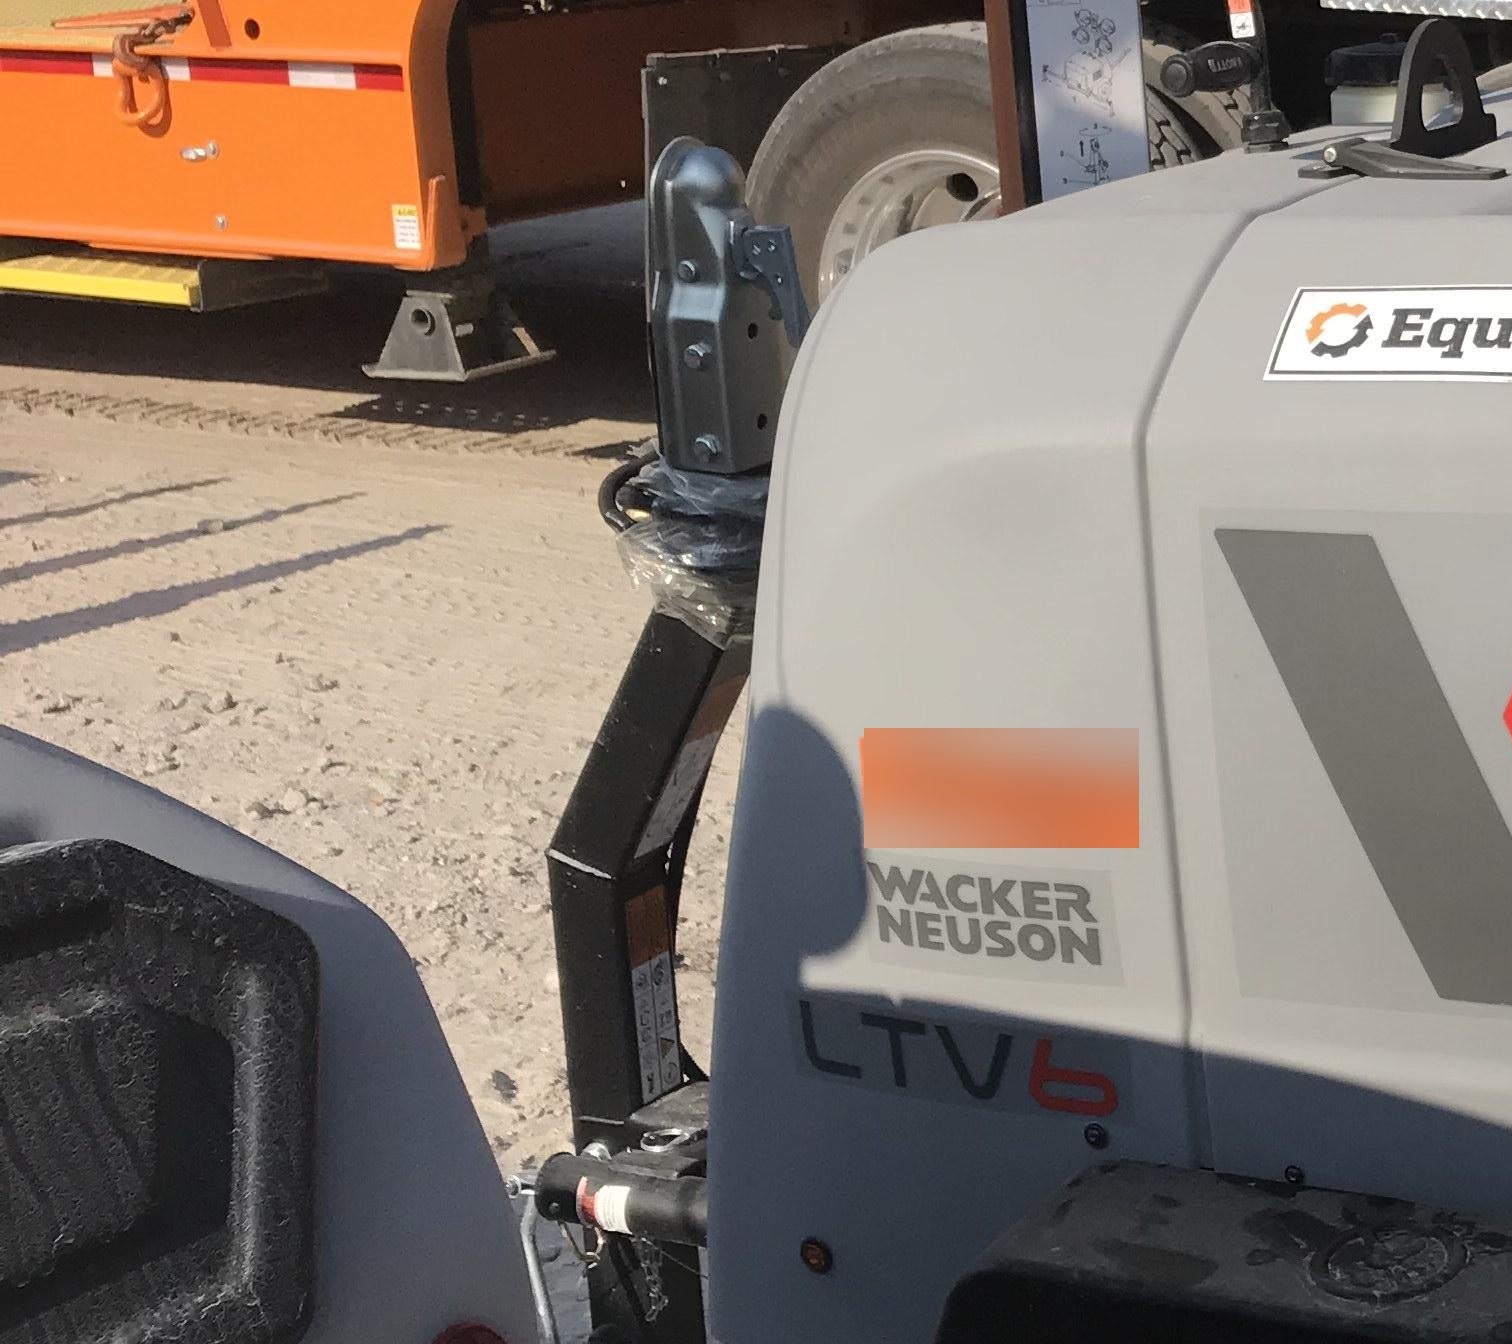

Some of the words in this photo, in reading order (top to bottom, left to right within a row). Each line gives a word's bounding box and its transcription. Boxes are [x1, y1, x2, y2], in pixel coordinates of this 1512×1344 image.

[866, 861, 1098, 923] WACKER
[876, 904, 1103, 966] NEUSON
[800, 1000, 1120, 1116] LTV6
